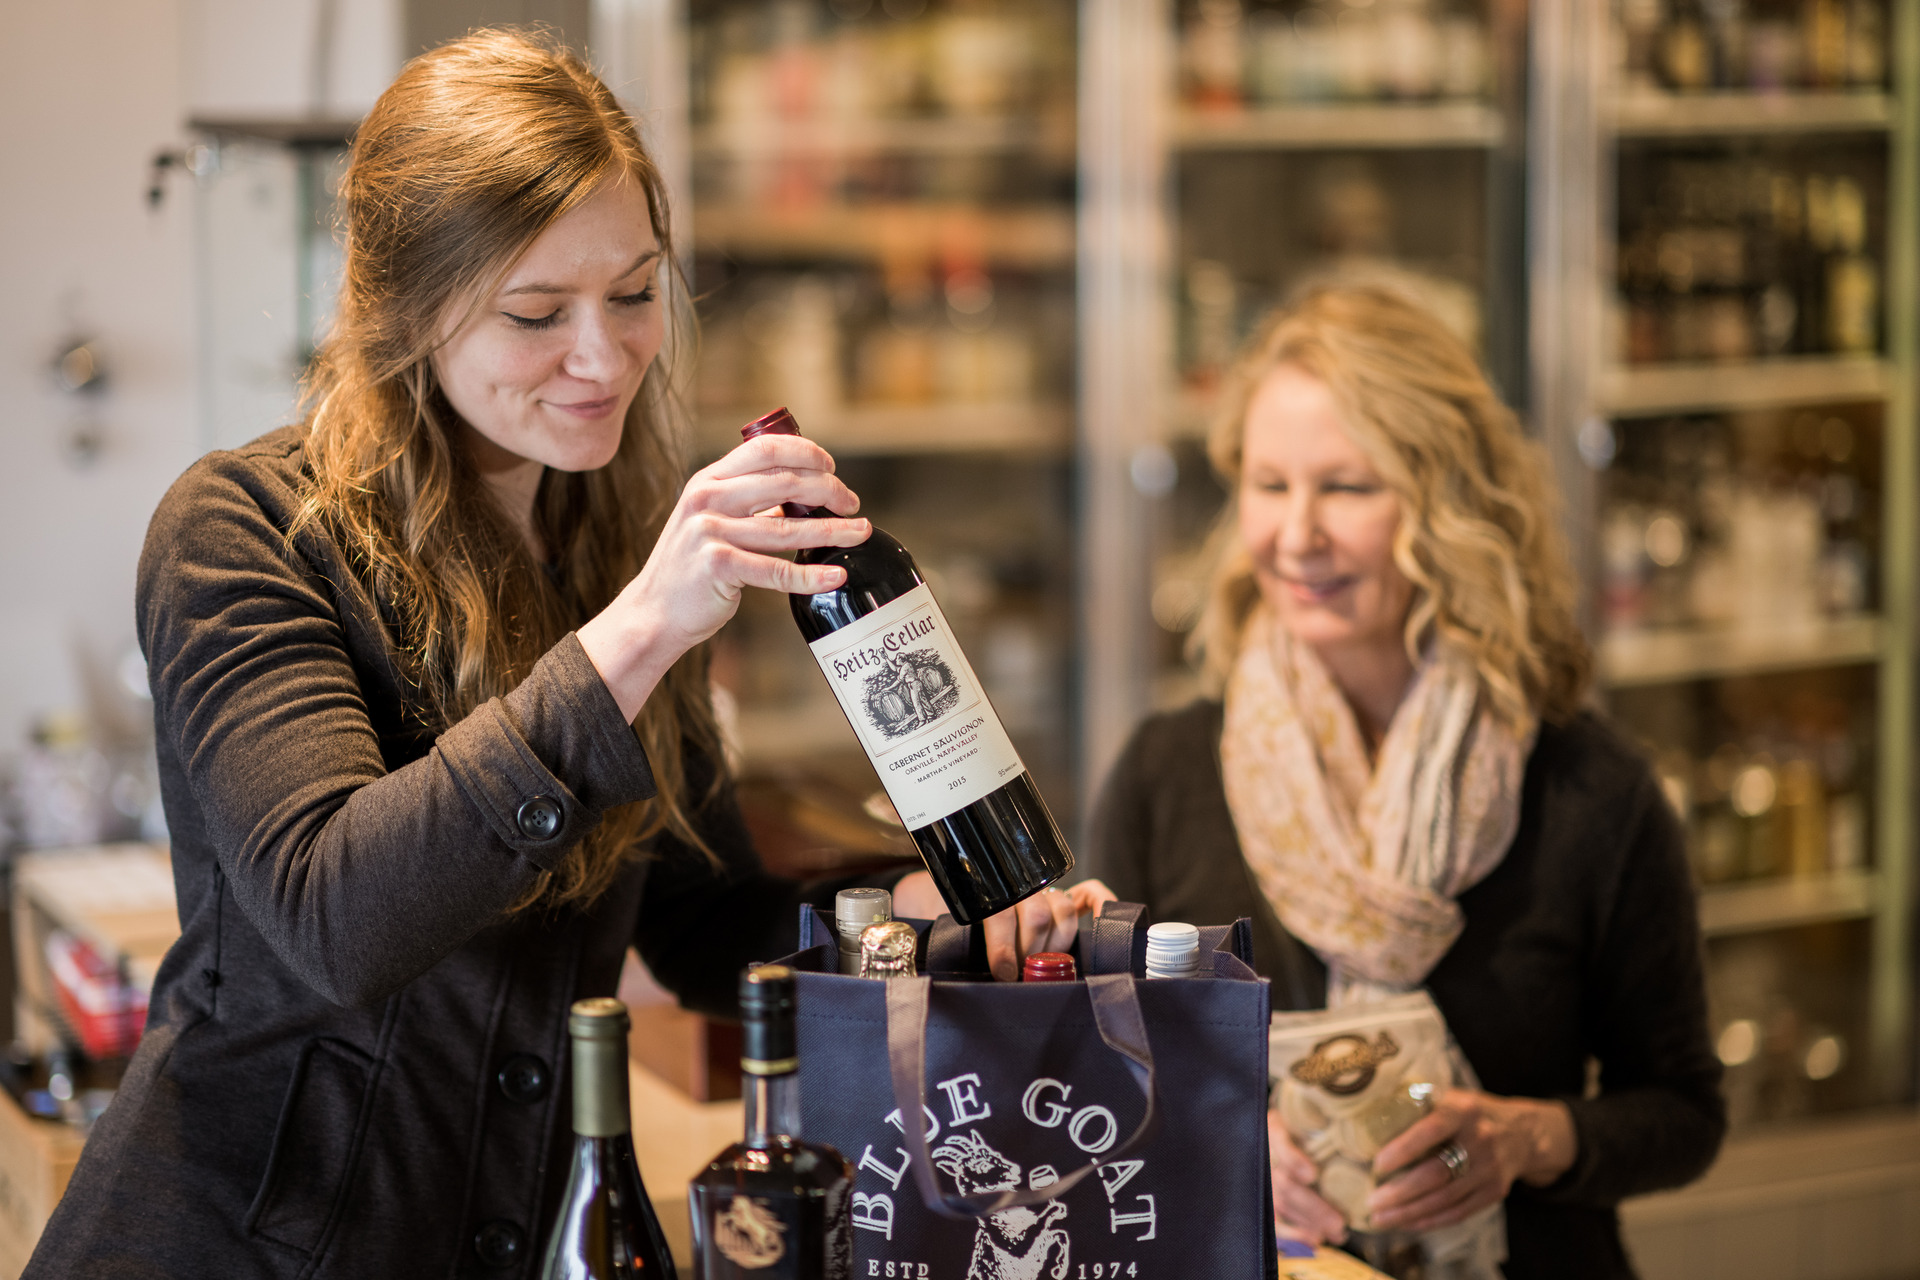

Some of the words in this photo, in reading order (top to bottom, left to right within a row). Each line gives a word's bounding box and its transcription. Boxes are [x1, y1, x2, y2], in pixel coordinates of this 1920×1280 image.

[833, 648, 881, 682] Heitz
[882, 615, 935, 652] Cellar
[889, 745, 931, 772] CABERNET
[933, 716, 985, 750] SAUVIGNON
[905, 756, 938, 775] OAKVILLE,
[937, 745, 957, 759] NAPA
[956, 733, 979, 751] VALLEY
[917, 764, 948, 784] MARTHA'S
[948, 747, 979, 767] VINEYARD
[947, 776, 967, 791] 2015
[1022, 1077, 1158, 1242] GOAT
[868, 1258, 929, 1280] ESTD
[1078, 1261, 1138, 1280] 1974
